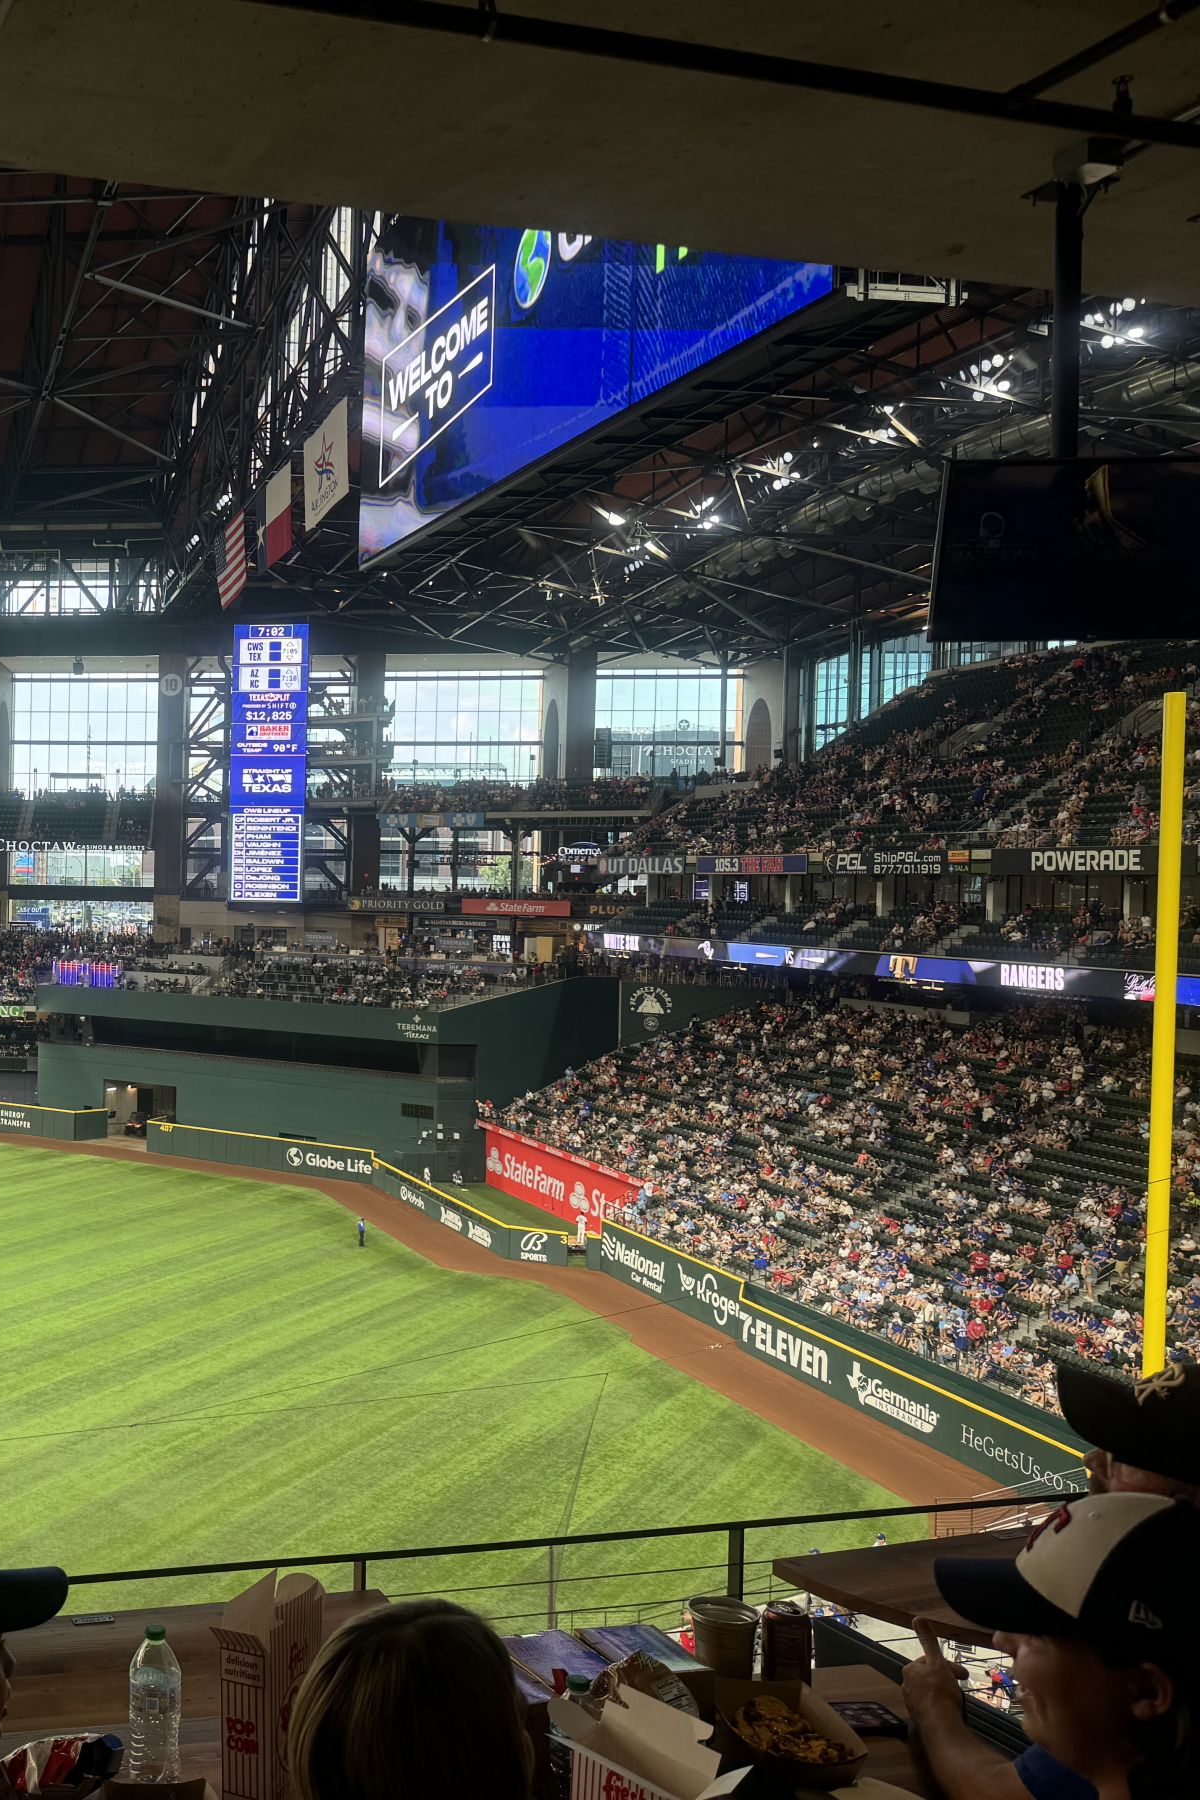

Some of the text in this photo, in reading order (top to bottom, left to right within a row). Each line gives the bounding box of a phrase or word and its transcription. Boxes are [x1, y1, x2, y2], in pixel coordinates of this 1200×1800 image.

[388, 297, 489, 412] WELCOME
[424, 373, 452, 418] TO
[258, 627, 284, 636] 7:02
[248, 642, 264, 651] CWS
[249, 652, 261, 661] TEX
[250, 668, 258, 678] AZ
[164, 678, 178, 691] 10
[250, 680, 259, 688] KC
[246, 710, 292, 722] $12,825
[242, 784, 292, 793] TEXAS
[714, 857, 784, 872] 105.3 THE FAN
[836, 854, 868, 870] PGL
[874, 852, 941, 864] ShipPGL.com
[1031, 849, 1142, 871] POWERADE
[608, 858, 626, 874] UT
[629, 858, 683, 874] DALLAS
[874, 864, 941, 874] 877.701.1919
[362, 899, 444, 911] PRIORITY GOLD
[590, 905, 628, 914] PLUC
[604, 934, 640, 950] WHITE SOX
[784, 950, 794, 964] VS
[1000, 964, 1064, 991] RANGERS
[396, 1022, 438, 1033] TEREMANA
[0, 1109, 25, 1120] ENERGY
[0, 1118, 32, 1129] TRANSFER
[160, 1124, 174, 1132] 407
[306, 1152, 373, 1175] Globe Life
[520, 1252, 548, 1262] SPORTS
[614, 1240, 665, 1283] National
[630, 1271, 662, 1294] Car Rental
[696, 1273, 740, 1326] Kroger
[870, 1378, 940, 1427] Germania
[875, 1400, 926, 1430] INSURANCE
[960, 1424, 1082, 1493] HeGetsUs.com
[226, 1654, 259, 1670] delicious
[224, 1666, 261, 1682] nutritious
[226, 1716, 256, 1737] POP
[226, 1734, 260, 1756] CORN
